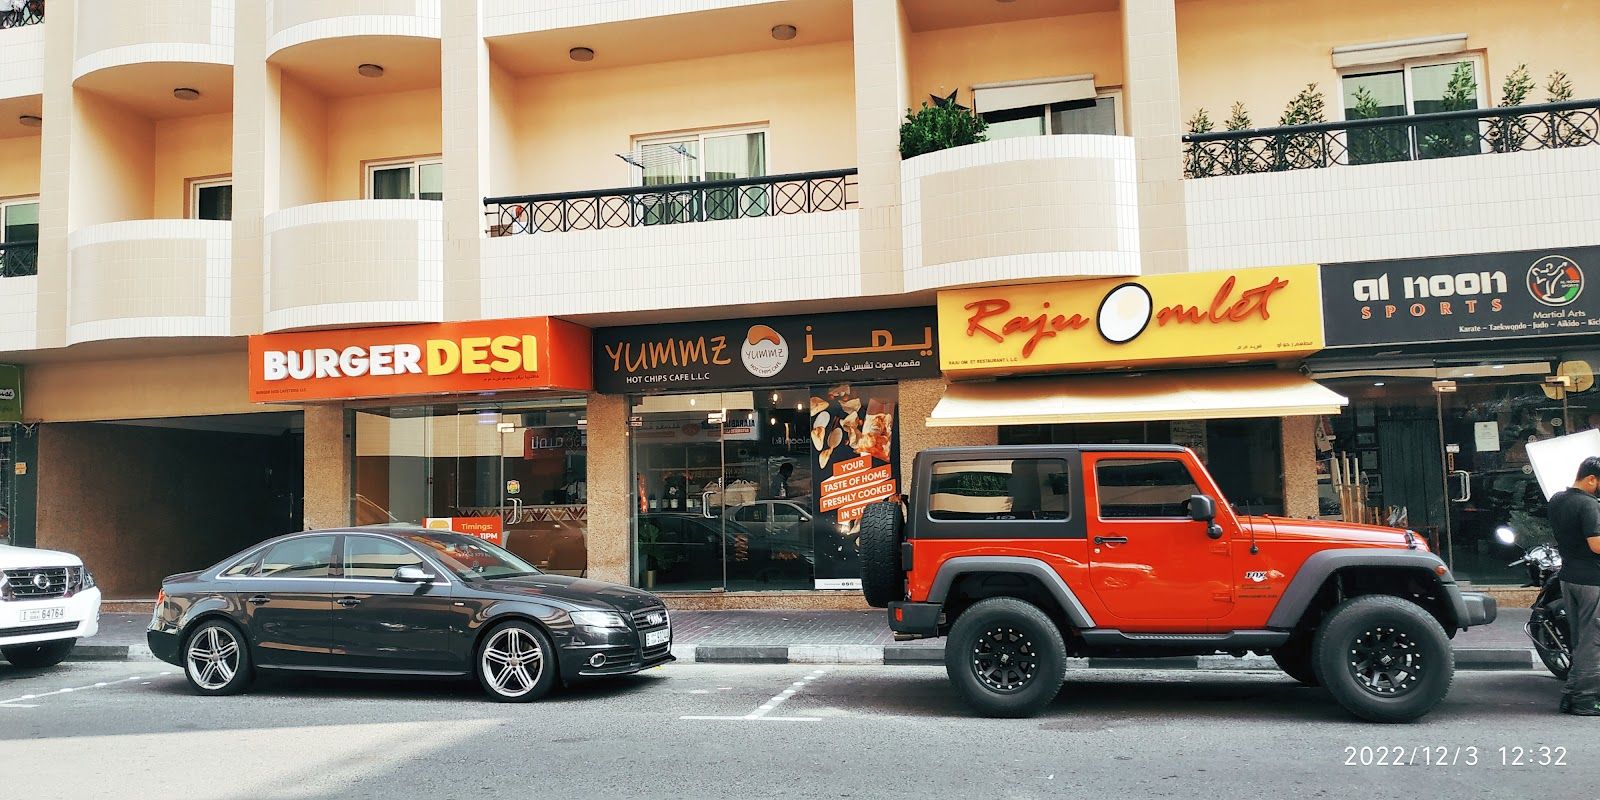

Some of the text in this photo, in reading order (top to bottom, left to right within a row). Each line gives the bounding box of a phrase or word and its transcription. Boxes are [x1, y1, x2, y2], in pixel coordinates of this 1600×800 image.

[1403, 270, 1508, 299] noon
[1361, 299, 1503, 319] SPORTS
[1533, 309, 1586, 319] Martial Arts
[964, 299, 1090, 359] Raju
[1459, 325, 1481, 333] Karate
[1488, 322, 1527, 331] Taekwondo
[1533, 321, 1549, 329] Judo
[1557, 319, 1580, 327] Aikido
[264, 335, 538, 381] BURGER DESI
[605, 336, 732, 372] YUMMZ
[746, 348, 784, 360] YUMMZ
[626, 372, 710, 384] HOT CHIPS CAFE L.L.C
[841, 459, 865, 472] YOUR
[823, 469, 890, 492] TASTE OF HOME,
[822, 483, 893, 508] FRESHLY COOKED
[841, 510, 850, 520] IN
[461, 523, 493, 531] Timings:
[41, 608, 64, 619] 64764
